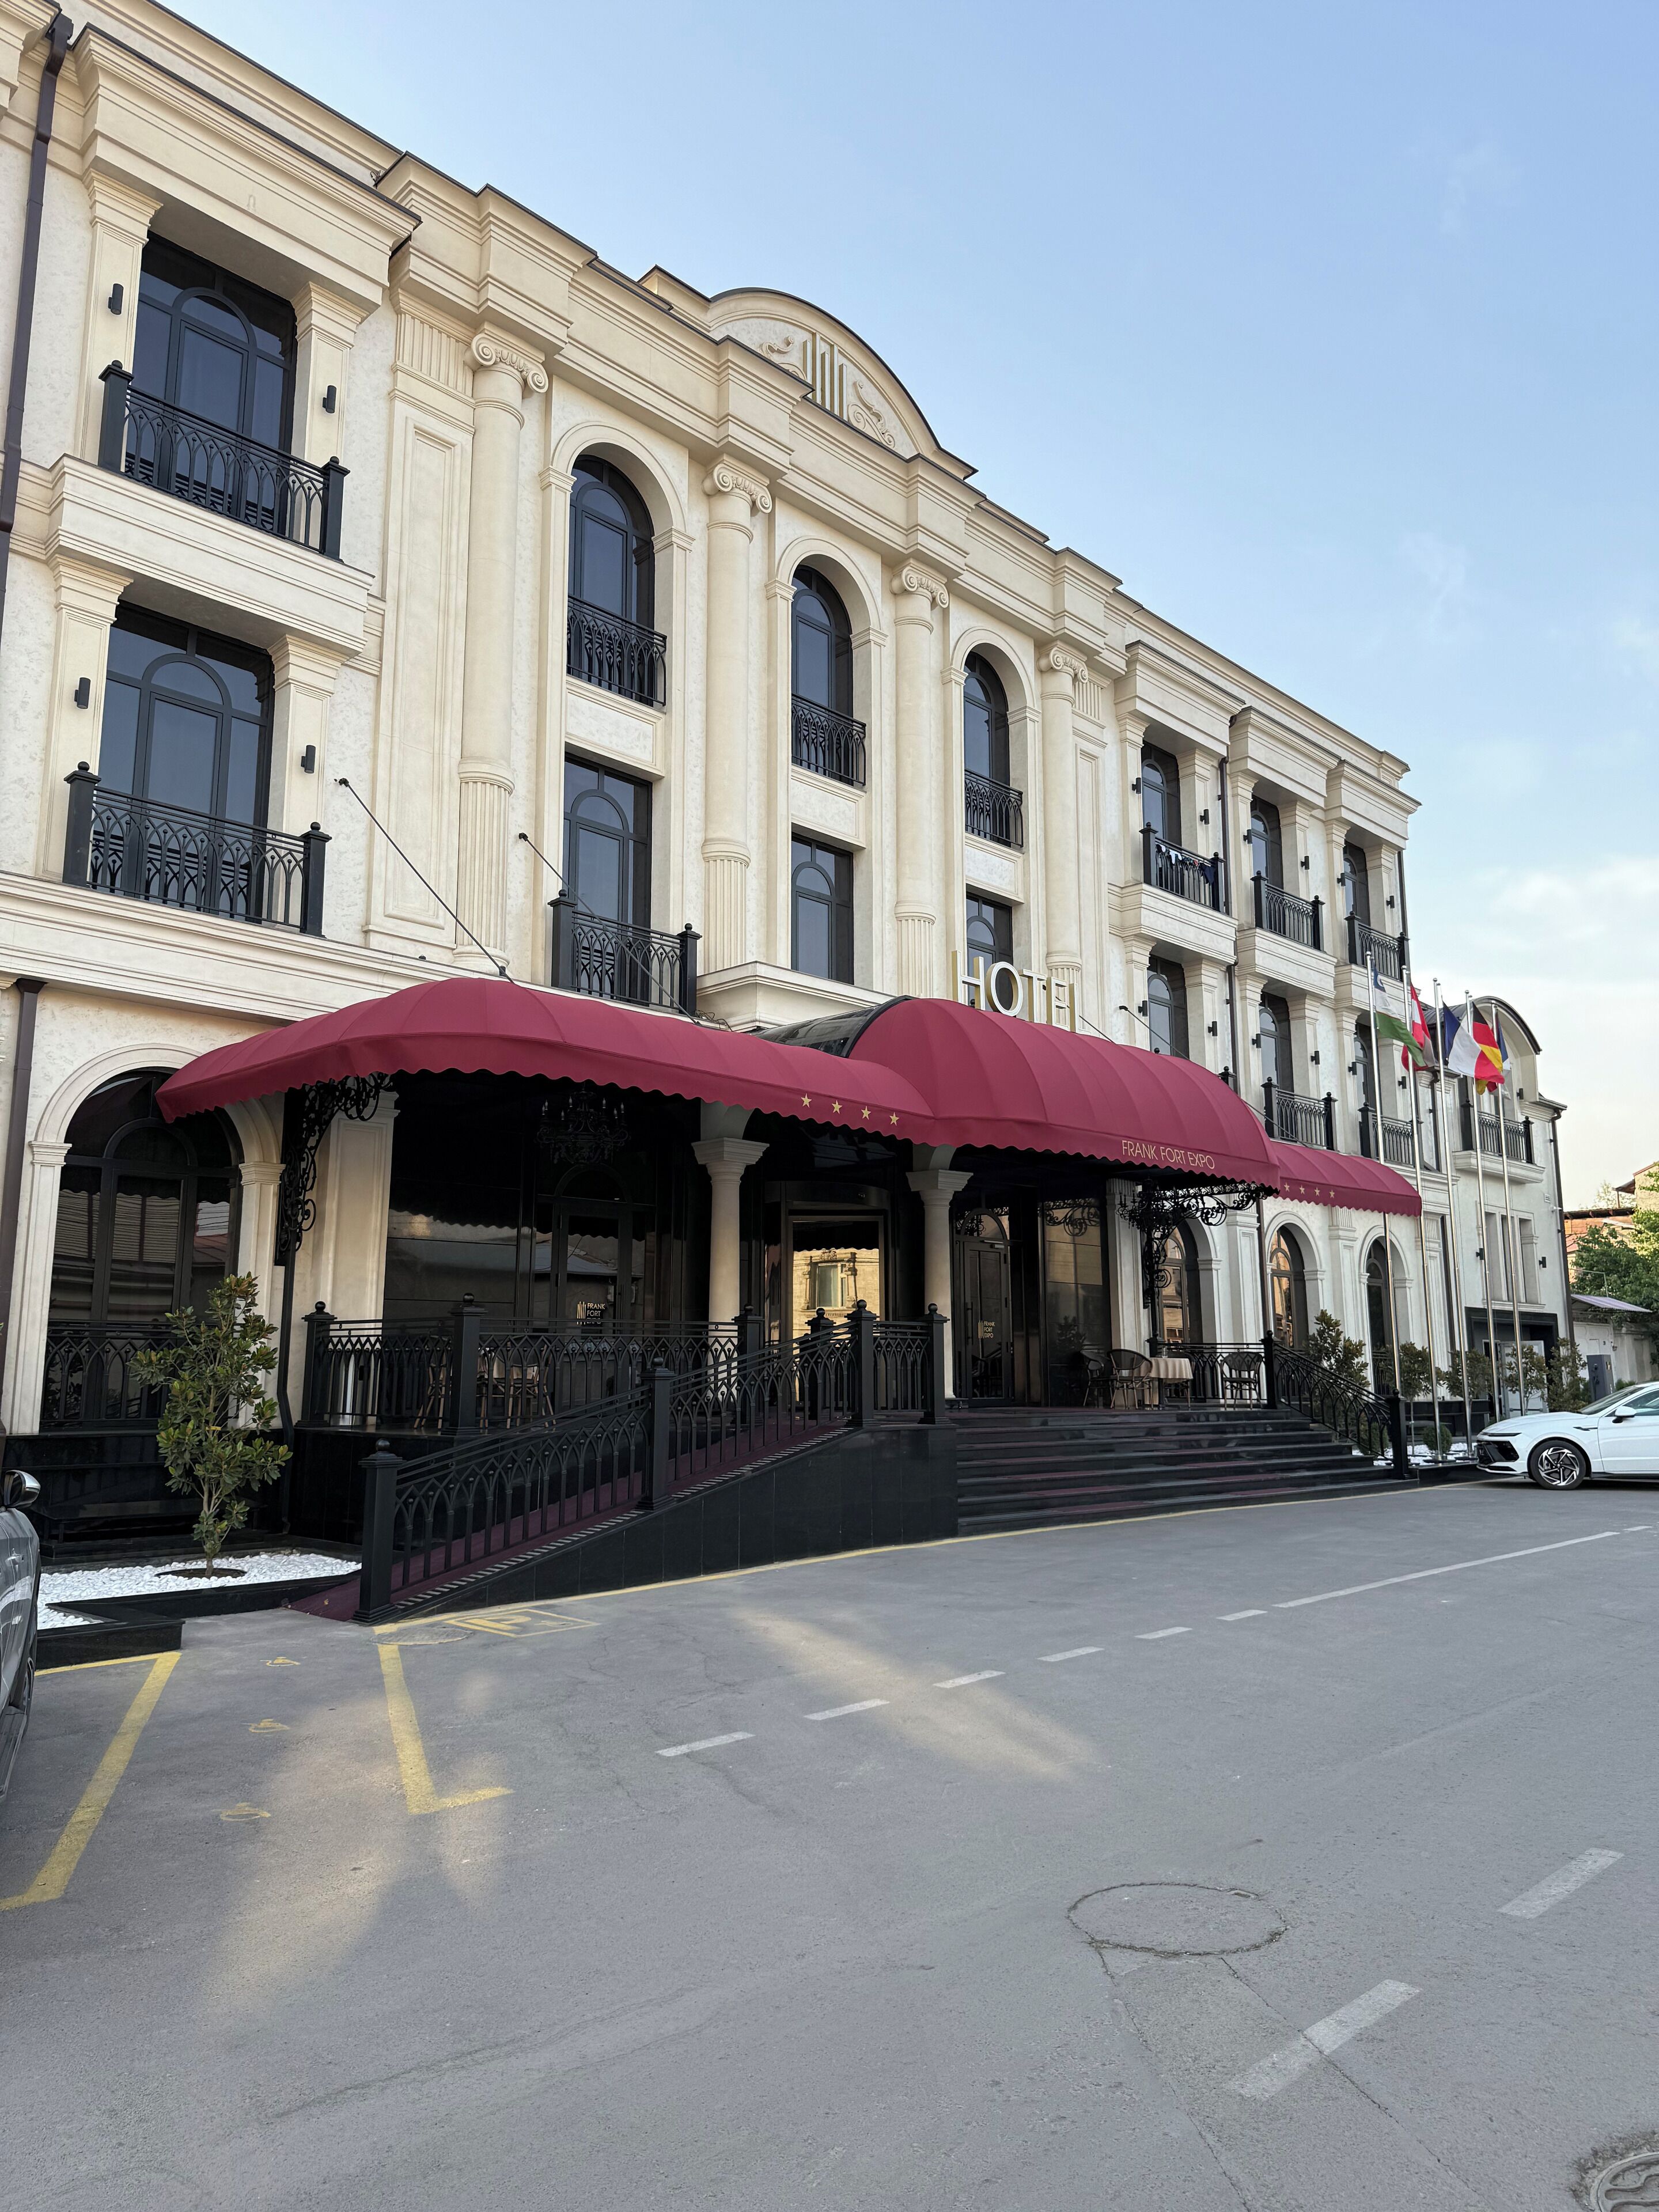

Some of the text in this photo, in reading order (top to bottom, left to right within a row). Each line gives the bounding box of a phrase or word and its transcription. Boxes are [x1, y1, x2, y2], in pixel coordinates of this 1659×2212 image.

[952, 950, 1092, 1036] HOTEL
[1122, 1140, 1215, 1169] FRANK FORT EXPO
